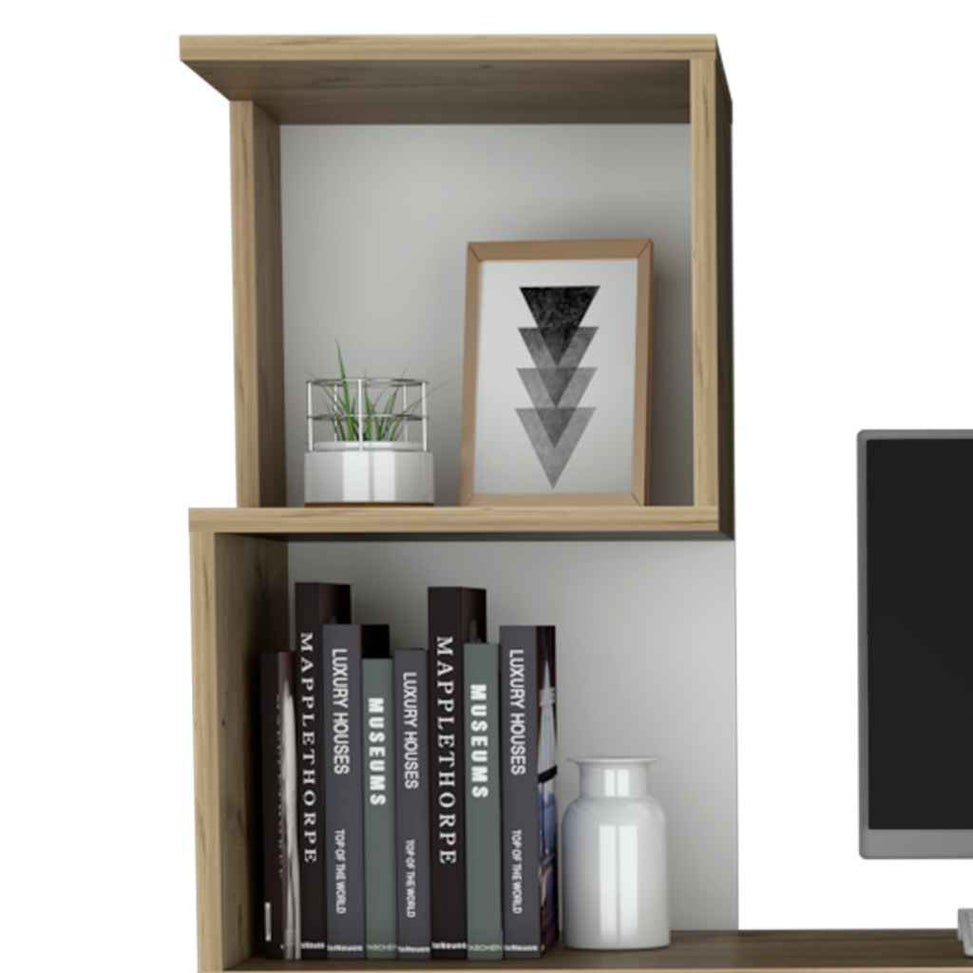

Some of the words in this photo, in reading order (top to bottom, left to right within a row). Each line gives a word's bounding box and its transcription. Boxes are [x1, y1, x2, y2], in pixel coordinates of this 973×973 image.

[332, 649, 348, 709] LUXURY
[403, 672, 418, 728] LUXURY
[510, 649, 526, 710] LUXURY
[300, 632, 317, 863] MAPPLETHORPE
[333, 712, 350, 775] HOUSES
[368, 697, 386, 806] MUSEUMS
[404, 731, 419, 789] HOUSES
[437, 635, 456, 864] MAPPLETHORPE
[470, 683, 488, 798] MUSEUMS
[510, 712, 527, 776] HOUSES
[512, 829, 522, 848] TOP
[512, 849, 522, 861] OF
[512, 863, 522, 880] THE
[512, 881, 523, 914] WORLD
